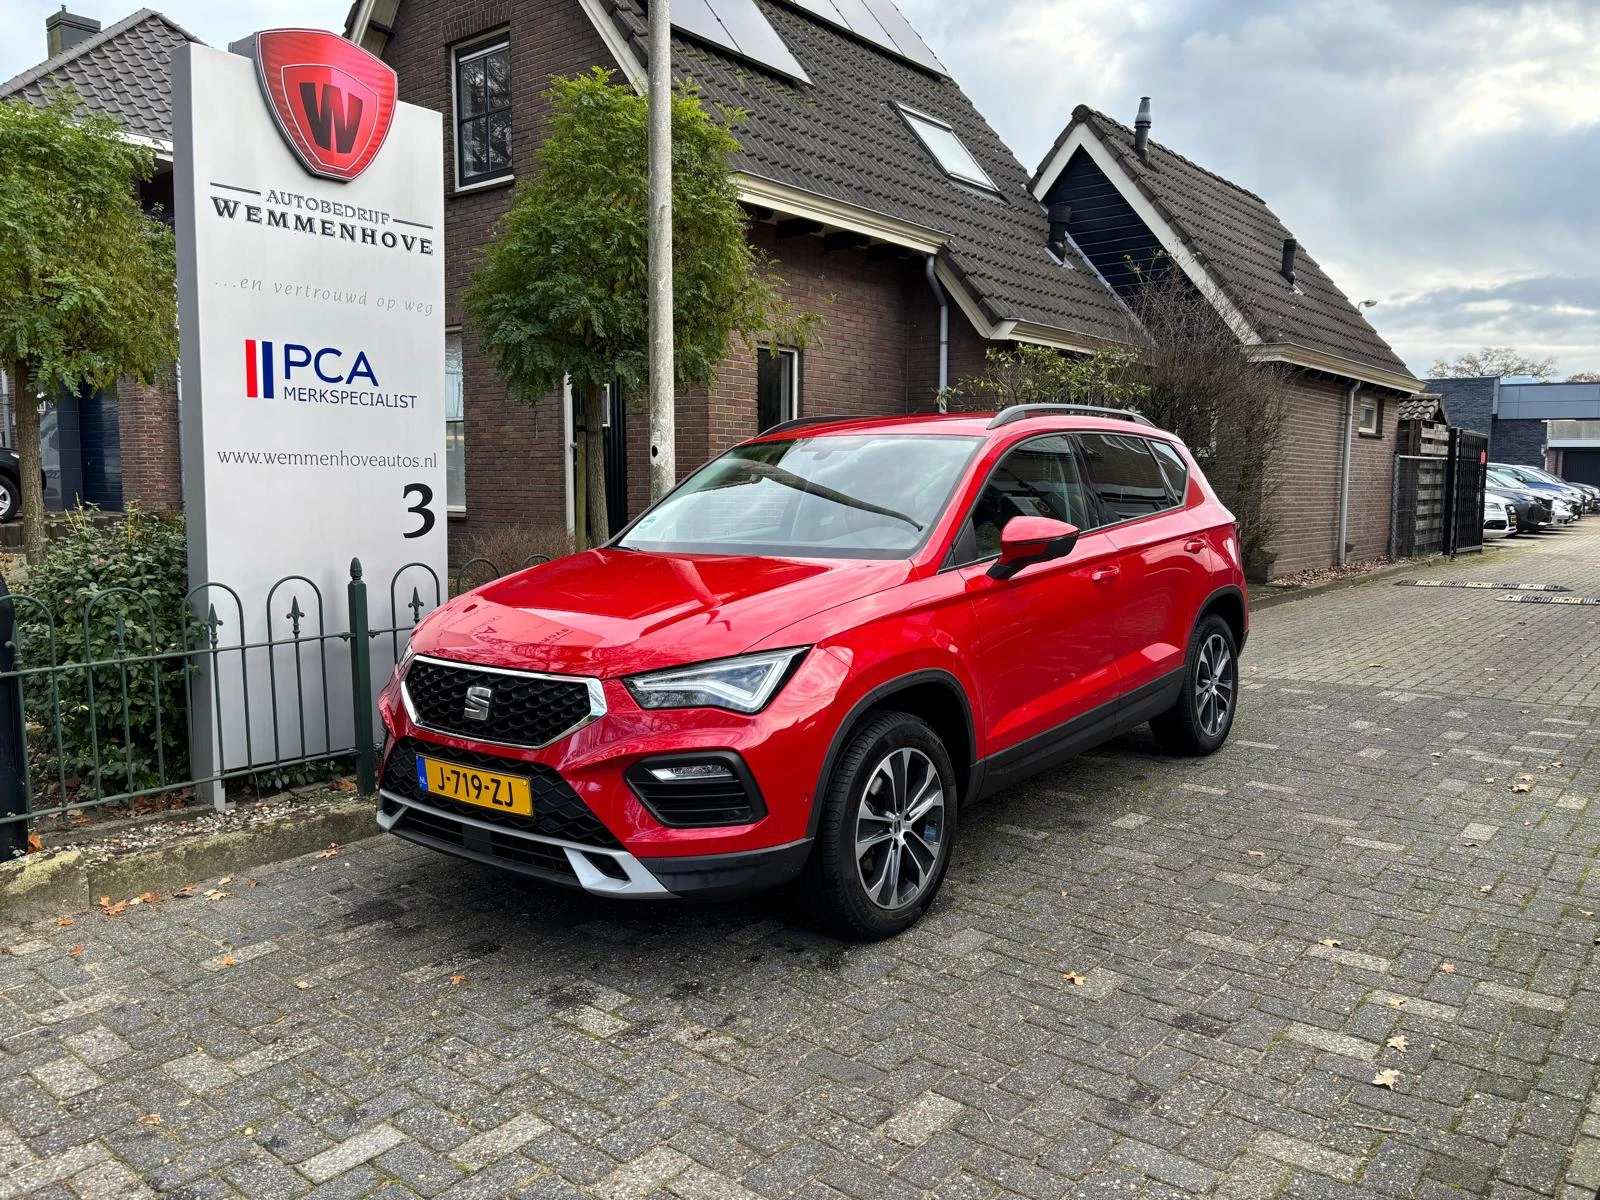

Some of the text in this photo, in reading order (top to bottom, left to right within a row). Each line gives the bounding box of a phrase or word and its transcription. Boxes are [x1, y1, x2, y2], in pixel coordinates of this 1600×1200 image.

[299, 82, 363, 154] W
[210, 195, 434, 256] WEMMENHOVE
[266, 189, 390, 225] AUTOBEDRIJF
[274, 281, 367, 305] vertrouwd
[376, 296, 396, 311] op
[405, 301, 433, 317] weg
[284, 343, 379, 387] PCA
[284, 386, 418, 409] MERKSPECIALIST
[217, 450, 438, 468] www.wemmenhoveautos.nl
[402, 482, 436, 539] 3
[438, 766, 514, 807] J-719-ZJ
